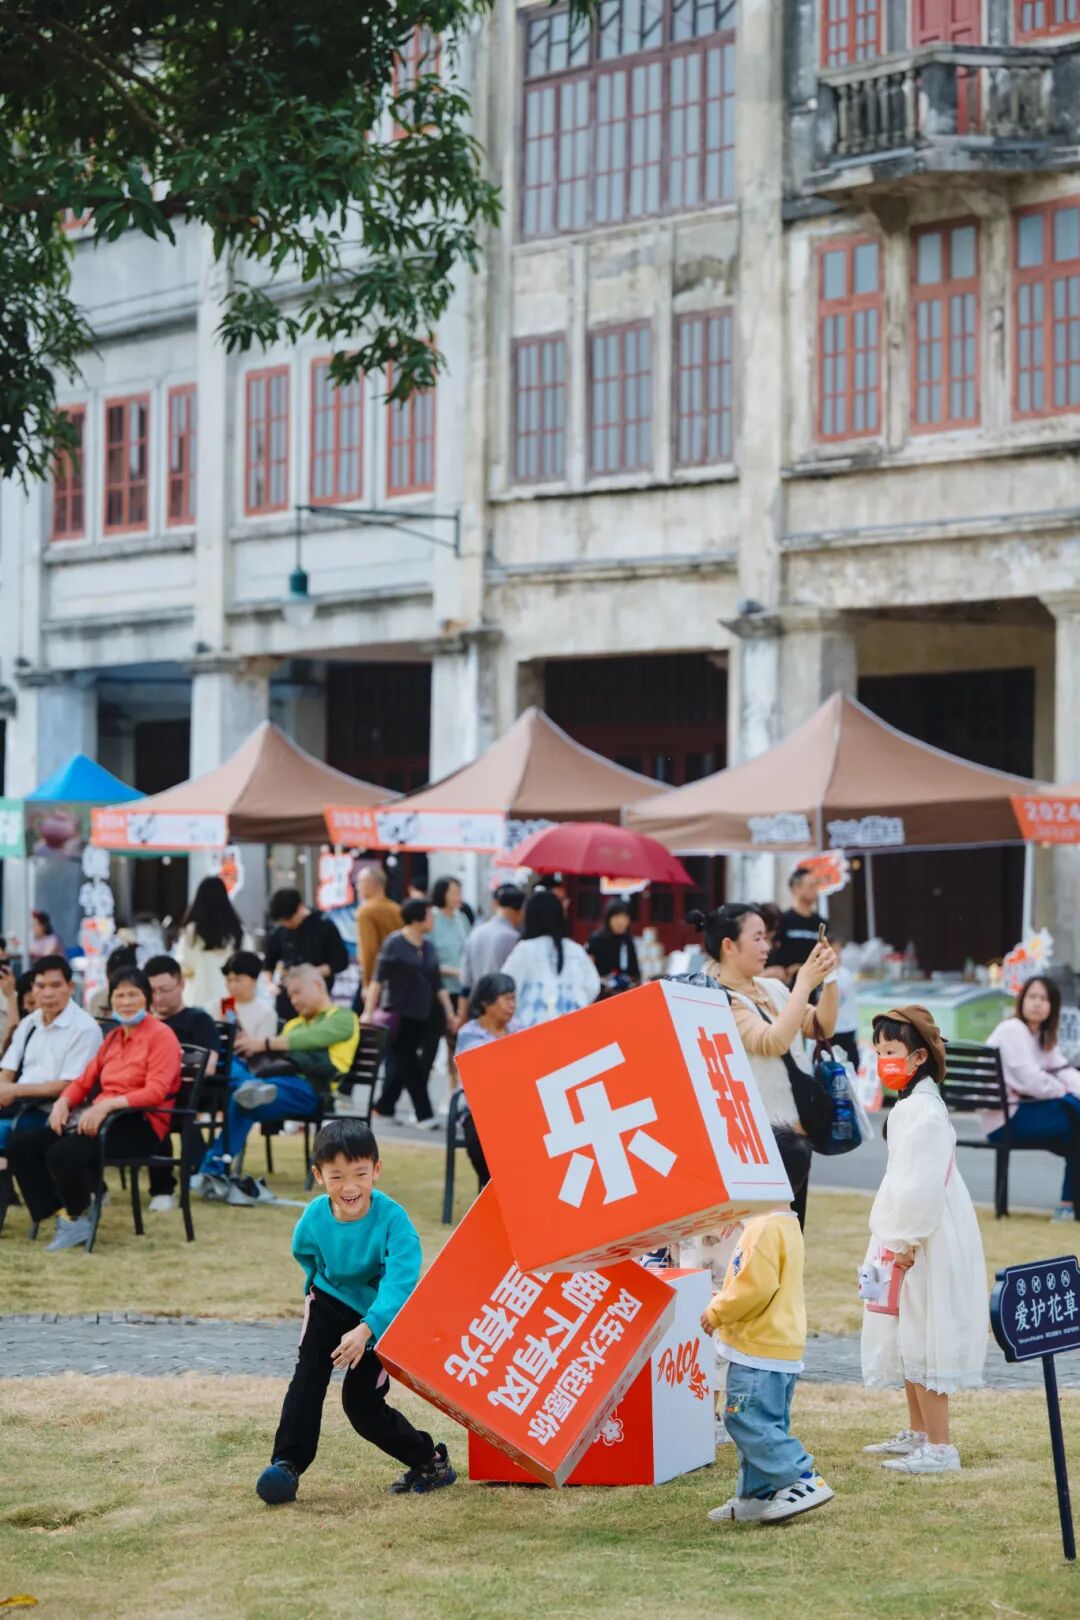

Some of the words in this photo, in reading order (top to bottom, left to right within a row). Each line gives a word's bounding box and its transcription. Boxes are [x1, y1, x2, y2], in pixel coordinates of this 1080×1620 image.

[535, 1042, 678, 1208] 乐
[697, 1026, 769, 1165] 新
[444, 1262, 556, 1387] 里有光
[487, 1270, 613, 1416] 脚下有风
[527, 1287, 643, 1446] 风生水起愿你
[1015, 1290, 1078, 1331] 爱护花草
